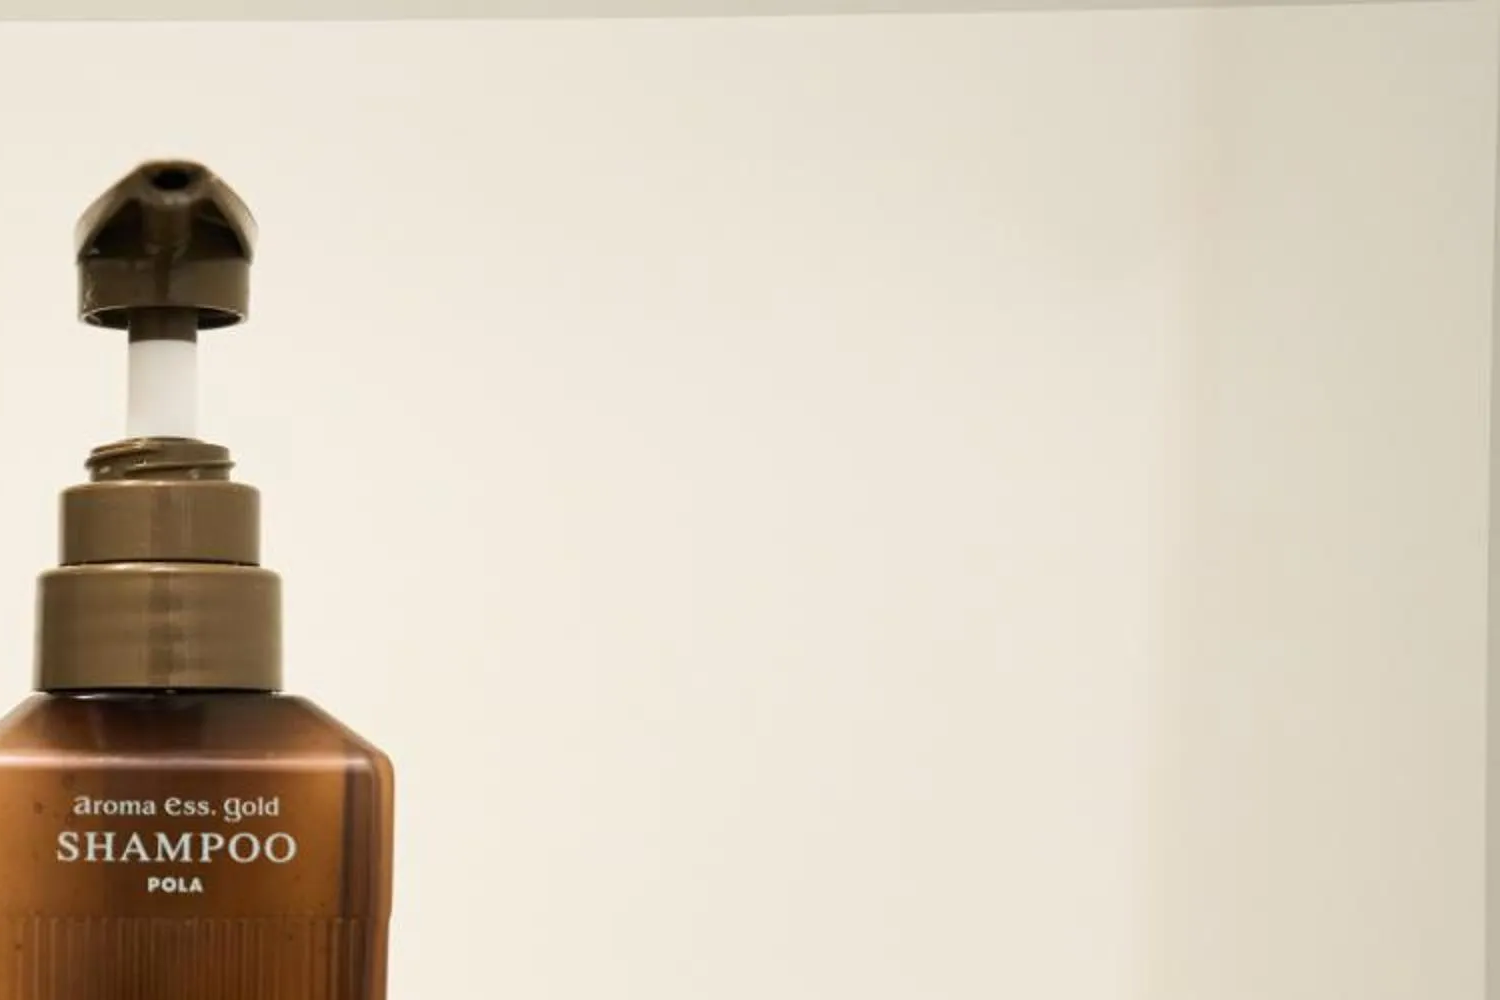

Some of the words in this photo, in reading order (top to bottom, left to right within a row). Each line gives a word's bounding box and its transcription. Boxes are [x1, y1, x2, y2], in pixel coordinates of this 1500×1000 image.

[73, 795, 156, 816] aroma
[164, 796, 216, 817] ess.
[223, 796, 280, 823] gold
[57, 831, 298, 864] SHAMPOO
[147, 876, 204, 893] POLA
